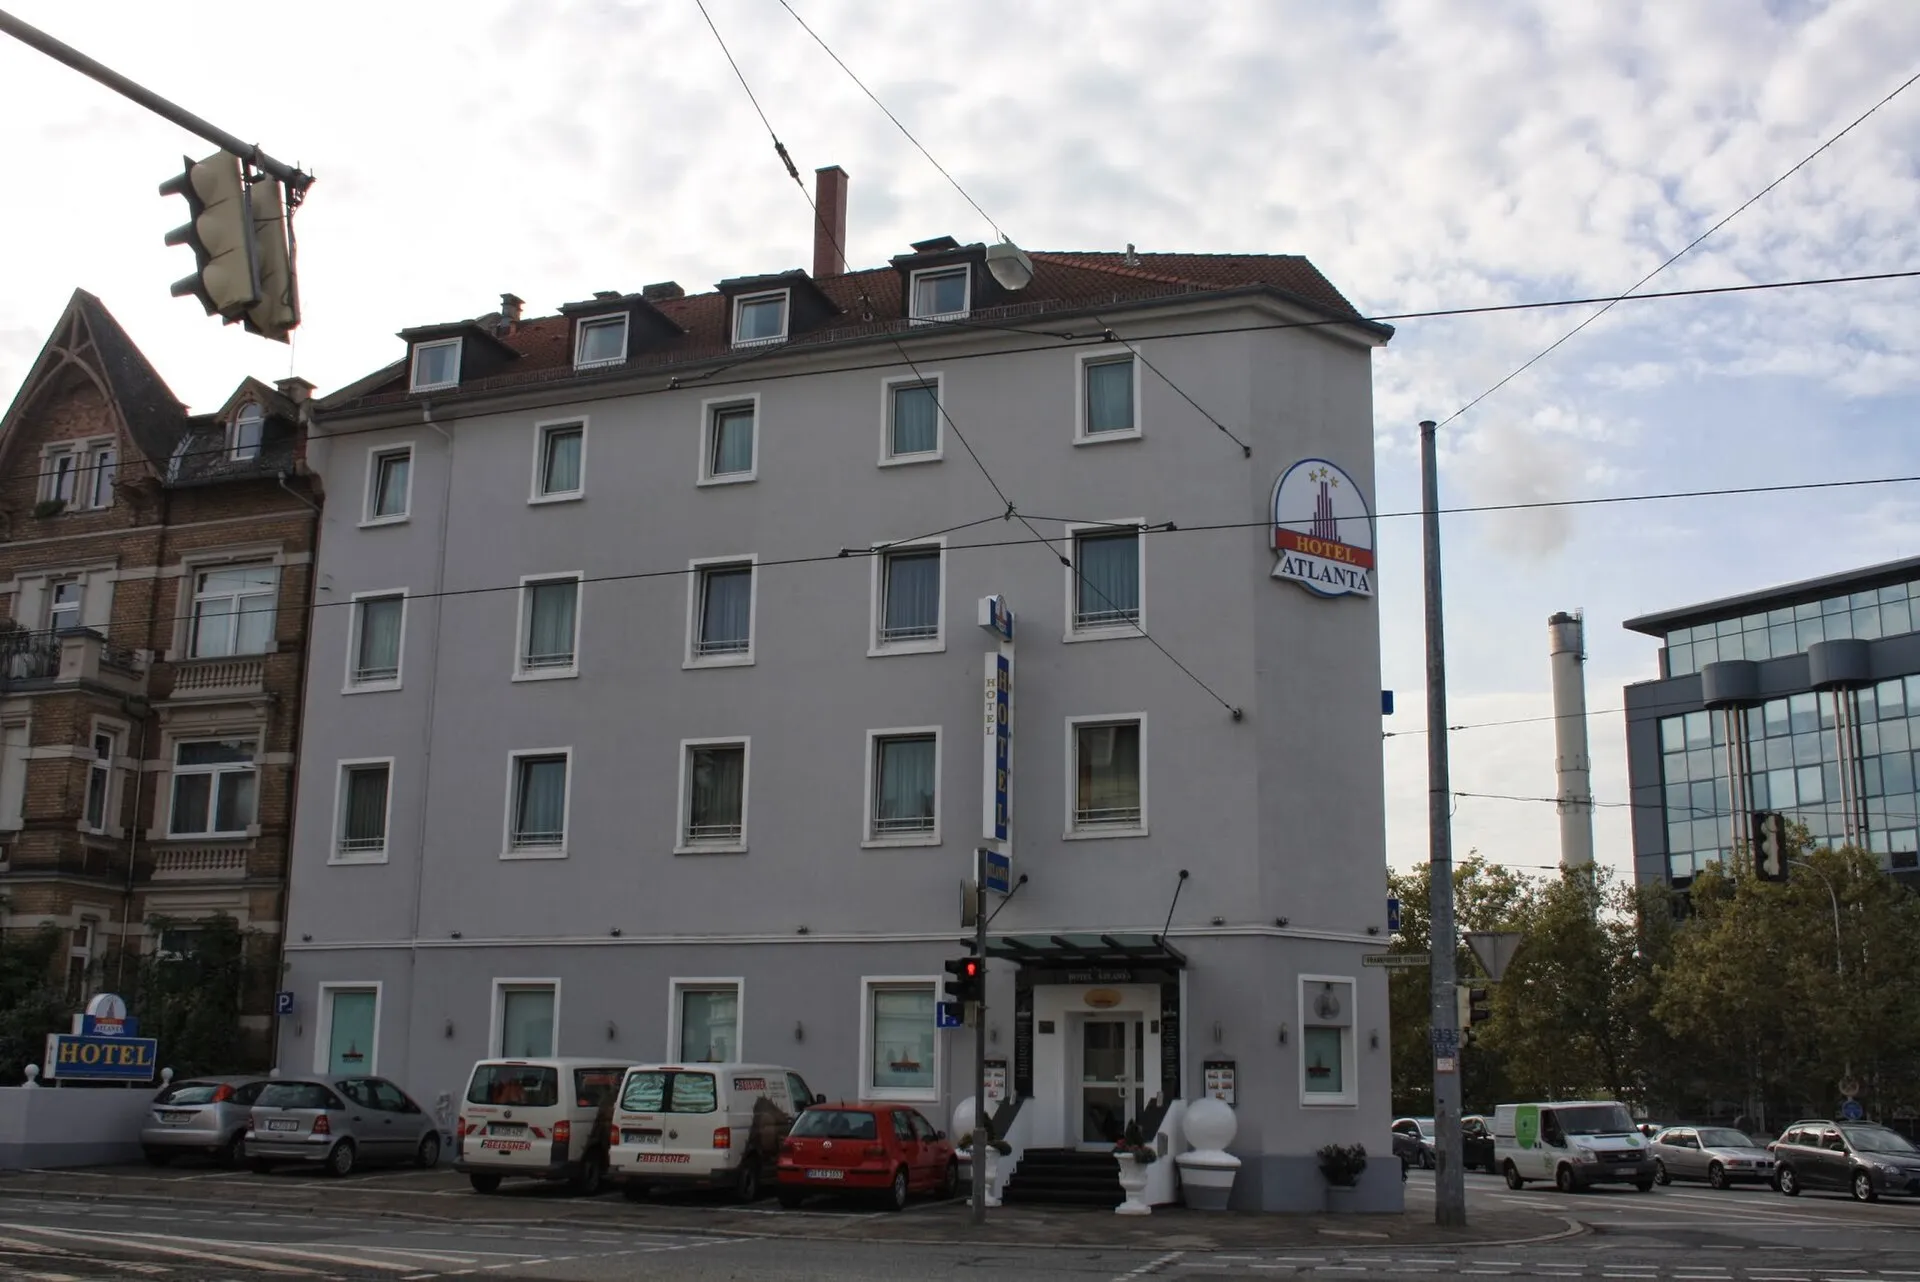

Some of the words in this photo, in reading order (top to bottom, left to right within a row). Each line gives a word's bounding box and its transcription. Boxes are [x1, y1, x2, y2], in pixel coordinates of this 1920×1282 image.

[1296, 535, 1356, 563] HOTEL
[1282, 556, 1370, 592] ATLANTA
[986, 679, 996, 735] HOTEL
[997, 667, 1008, 826] HOTEL
[279, 995, 290, 1012] P
[60, 1043, 151, 1065] HOTEL
